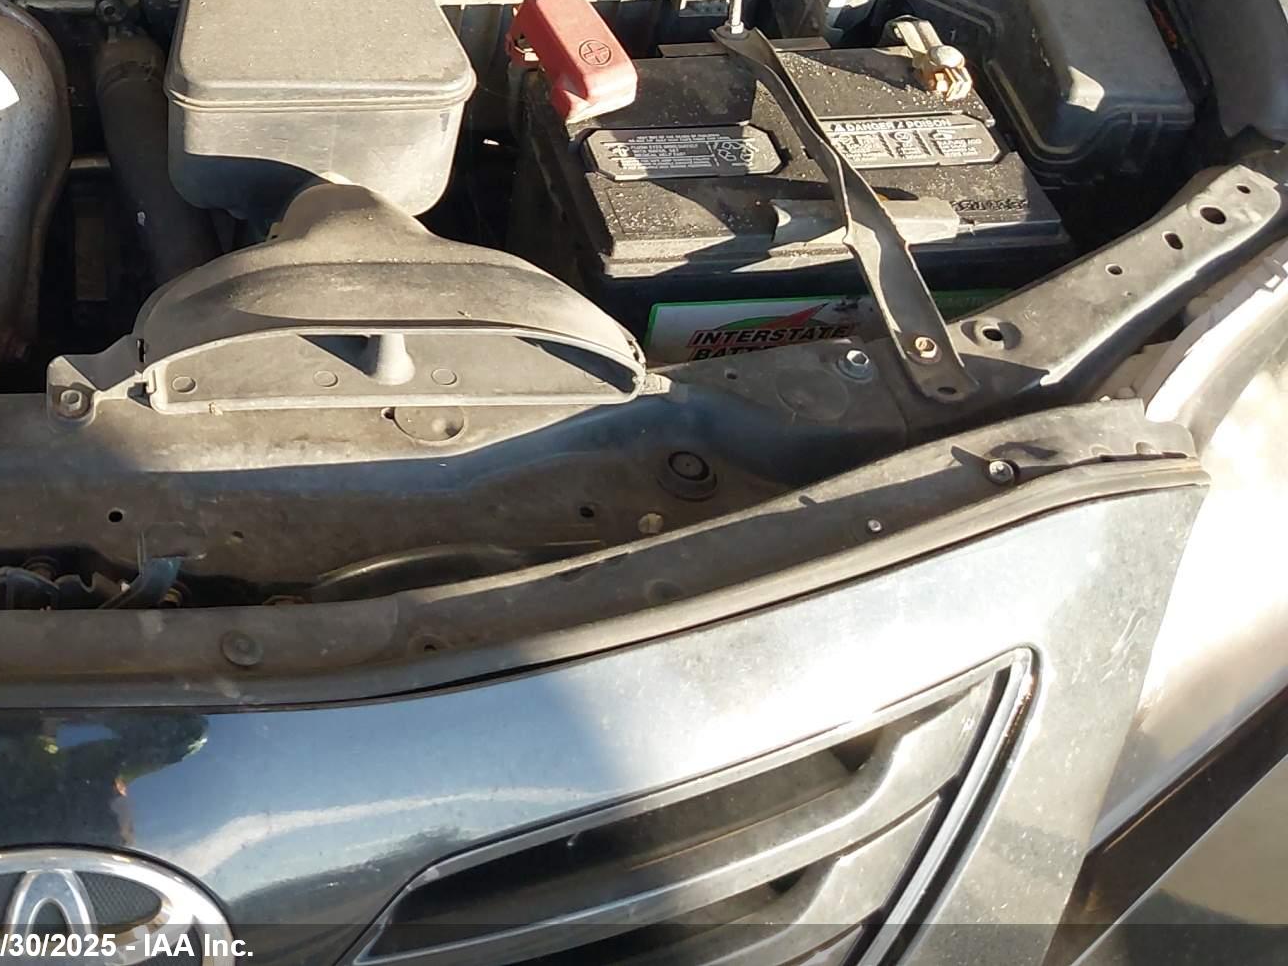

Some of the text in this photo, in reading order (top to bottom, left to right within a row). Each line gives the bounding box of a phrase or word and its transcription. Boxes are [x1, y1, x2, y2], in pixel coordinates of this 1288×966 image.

[845, 122, 894, 132] DANGER
[906, 119, 952, 129] POISON
[692, 325, 850, 345] INTERSTATE
